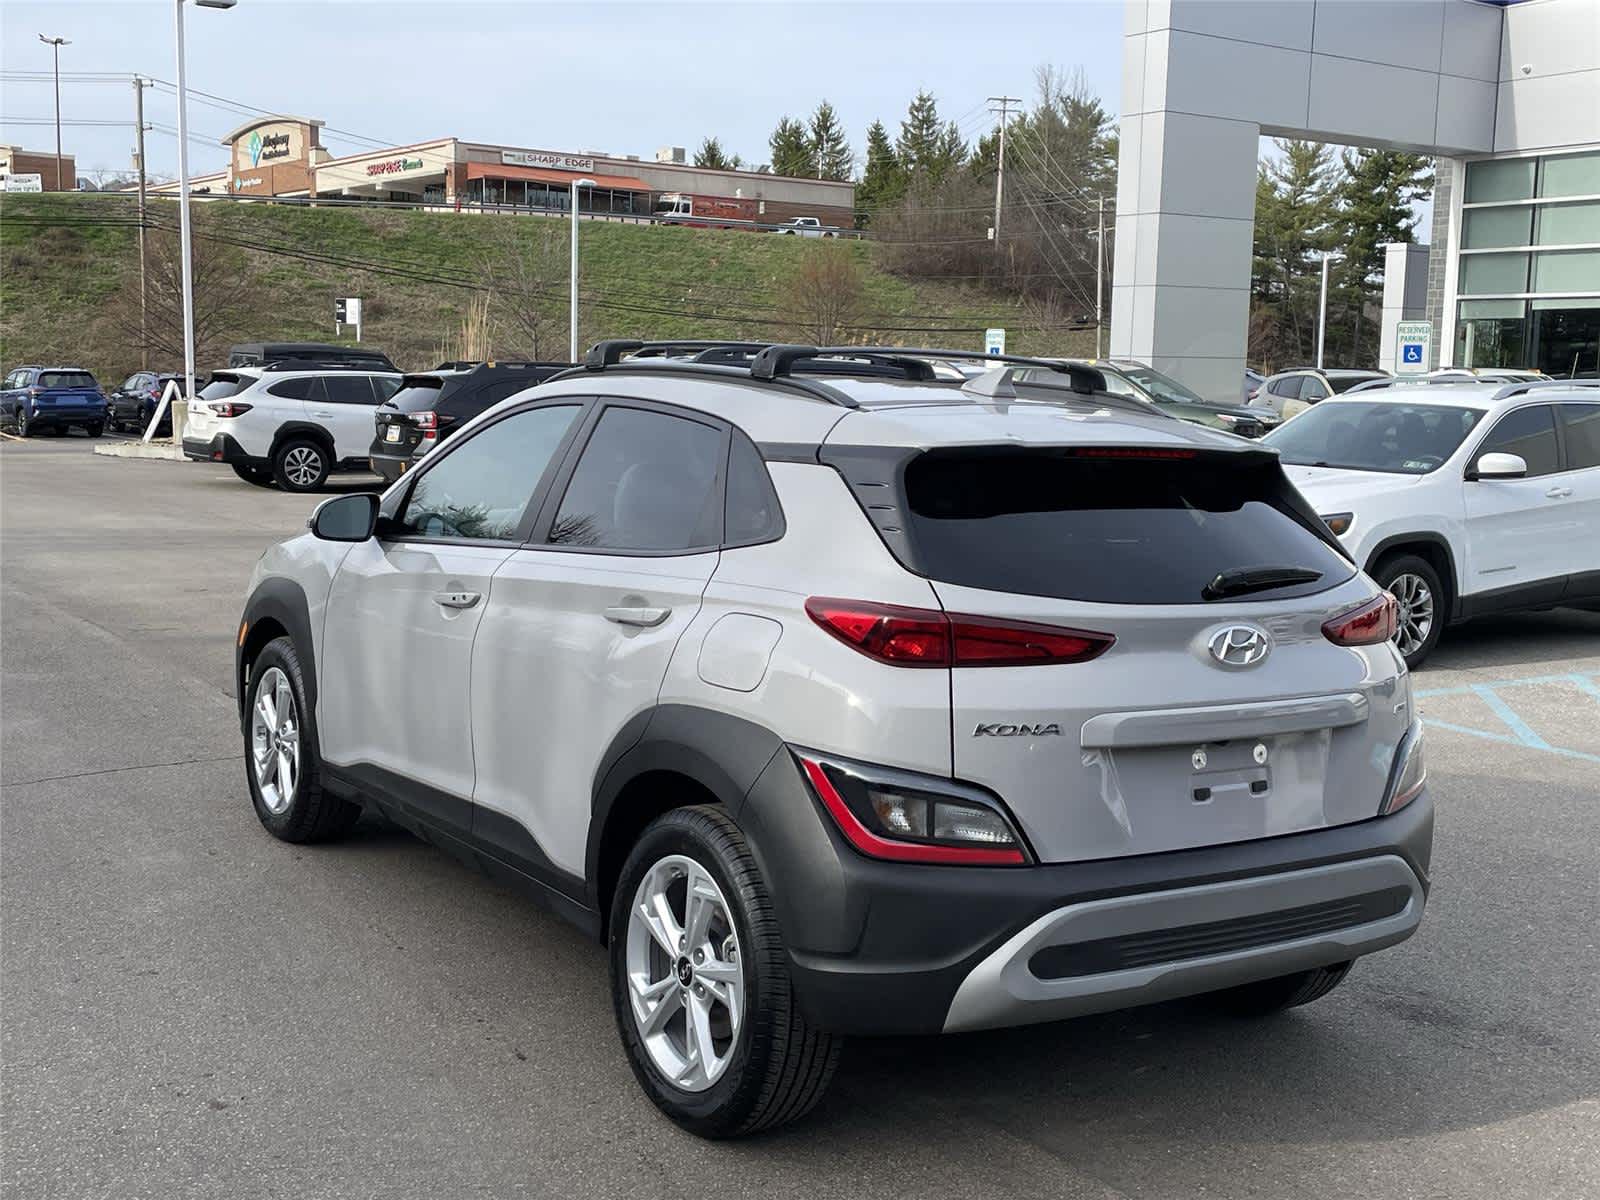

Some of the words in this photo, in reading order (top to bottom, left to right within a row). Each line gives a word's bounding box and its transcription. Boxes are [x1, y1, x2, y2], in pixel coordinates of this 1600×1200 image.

[526, 153, 561, 165] SHARP
[565, 158, 592, 168] EDGE
[1400, 326, 1430, 334] RESERVED
[1400, 335, 1428, 343] PARKING
[972, 722, 1064, 737] KONA
